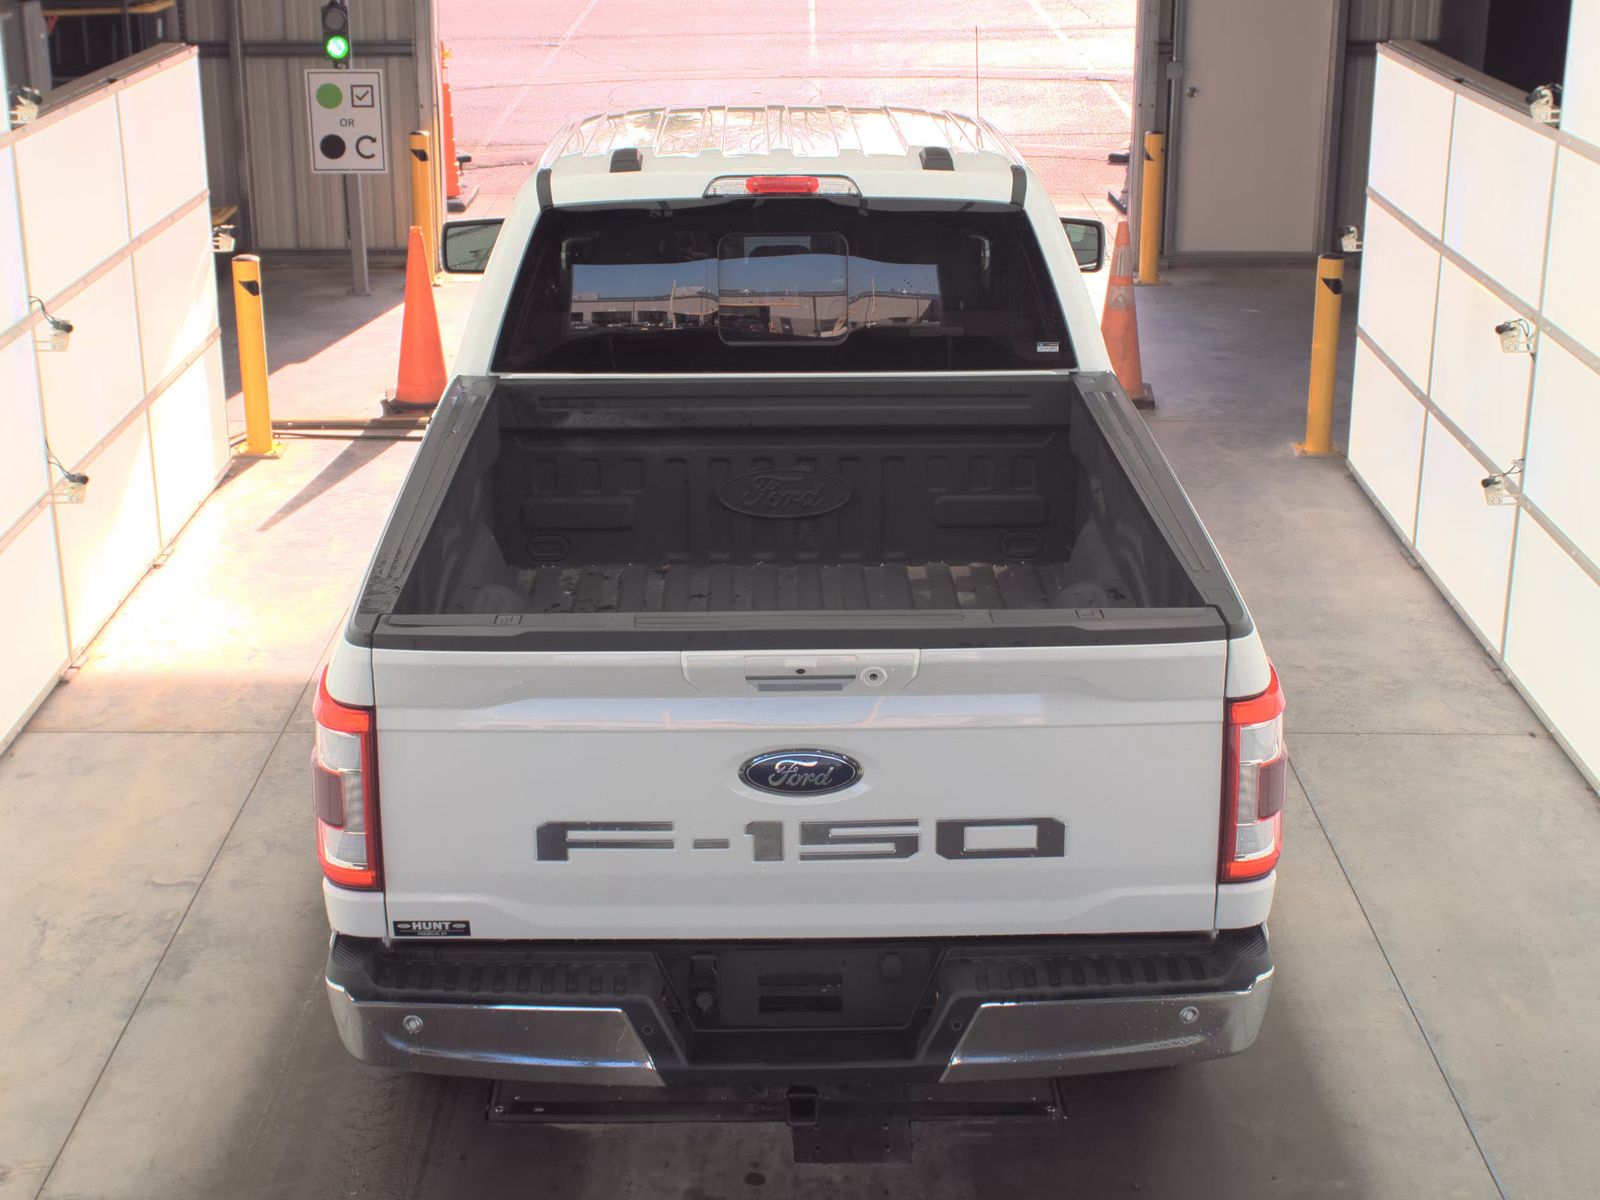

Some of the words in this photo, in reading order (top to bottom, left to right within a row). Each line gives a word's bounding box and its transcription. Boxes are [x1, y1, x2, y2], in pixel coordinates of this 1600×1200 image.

[340, 118, 355, 128] OR
[743, 475, 825, 507] Ford
[768, 760, 834, 786] Ford
[536, 817, 1066, 861] F-150
[411, 921, 451, 930] HUNT
